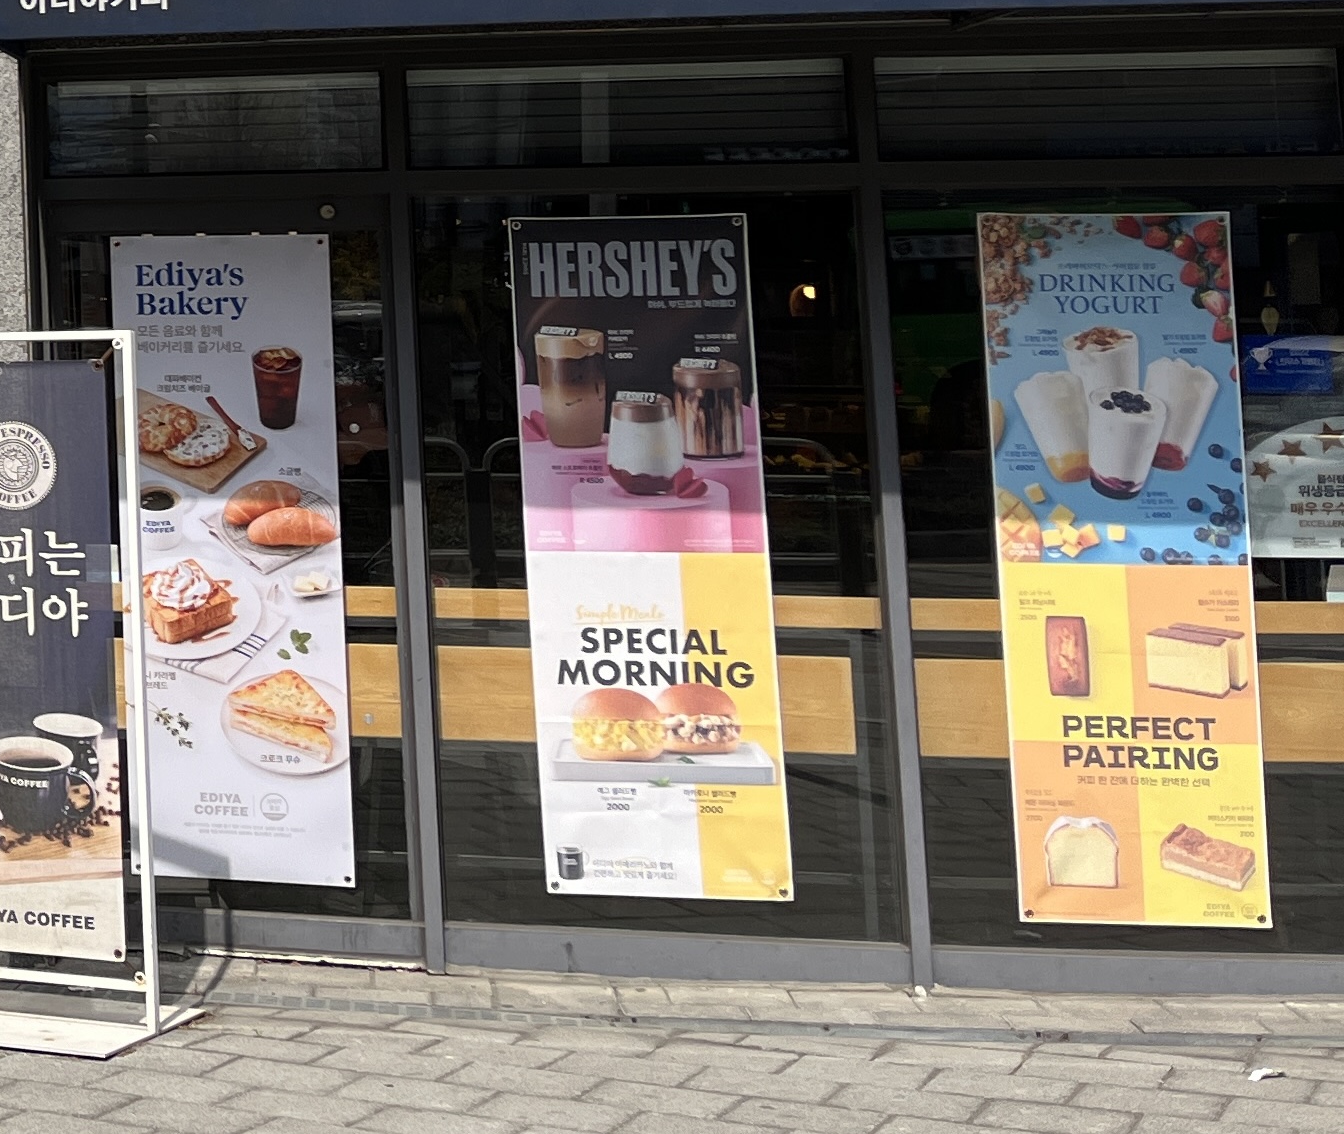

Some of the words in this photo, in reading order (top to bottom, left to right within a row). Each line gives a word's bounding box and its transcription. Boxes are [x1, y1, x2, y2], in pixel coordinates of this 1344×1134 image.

[134, 260, 245, 292] Ediya's
[528, 238, 738, 298] HERSHEY'S
[1038, 272, 1176, 294] DRINKING
[135, 290, 250, 321] Bakery
[1054, 295, 1163, 315] YOGURT
[137, 324, 160, 338] 모든
[163, 324, 196, 338] 음료와
[200, 324, 224, 338] 함께
[137, 341, 194, 354] 베이커리를
[198, 341, 245, 354] 즐기세요
[1299, 519, 1344, 528] EXCELLEN
[581, 626, 728, 656] SPECIAL
[557, 659, 755, 689] MORNING
[1062, 714, 1217, 742] PERFECT
[1063, 744, 1219, 772] PAIRING
[1077, 775, 1096, 785] 커피
[200, 792, 242, 804] EDIYA
[606, 803, 630, 811] 2000
[194, 805, 249, 817] COFFEE
[699, 805, 724, 814] 2000
[23, 910, 96, 930] COFFEE
